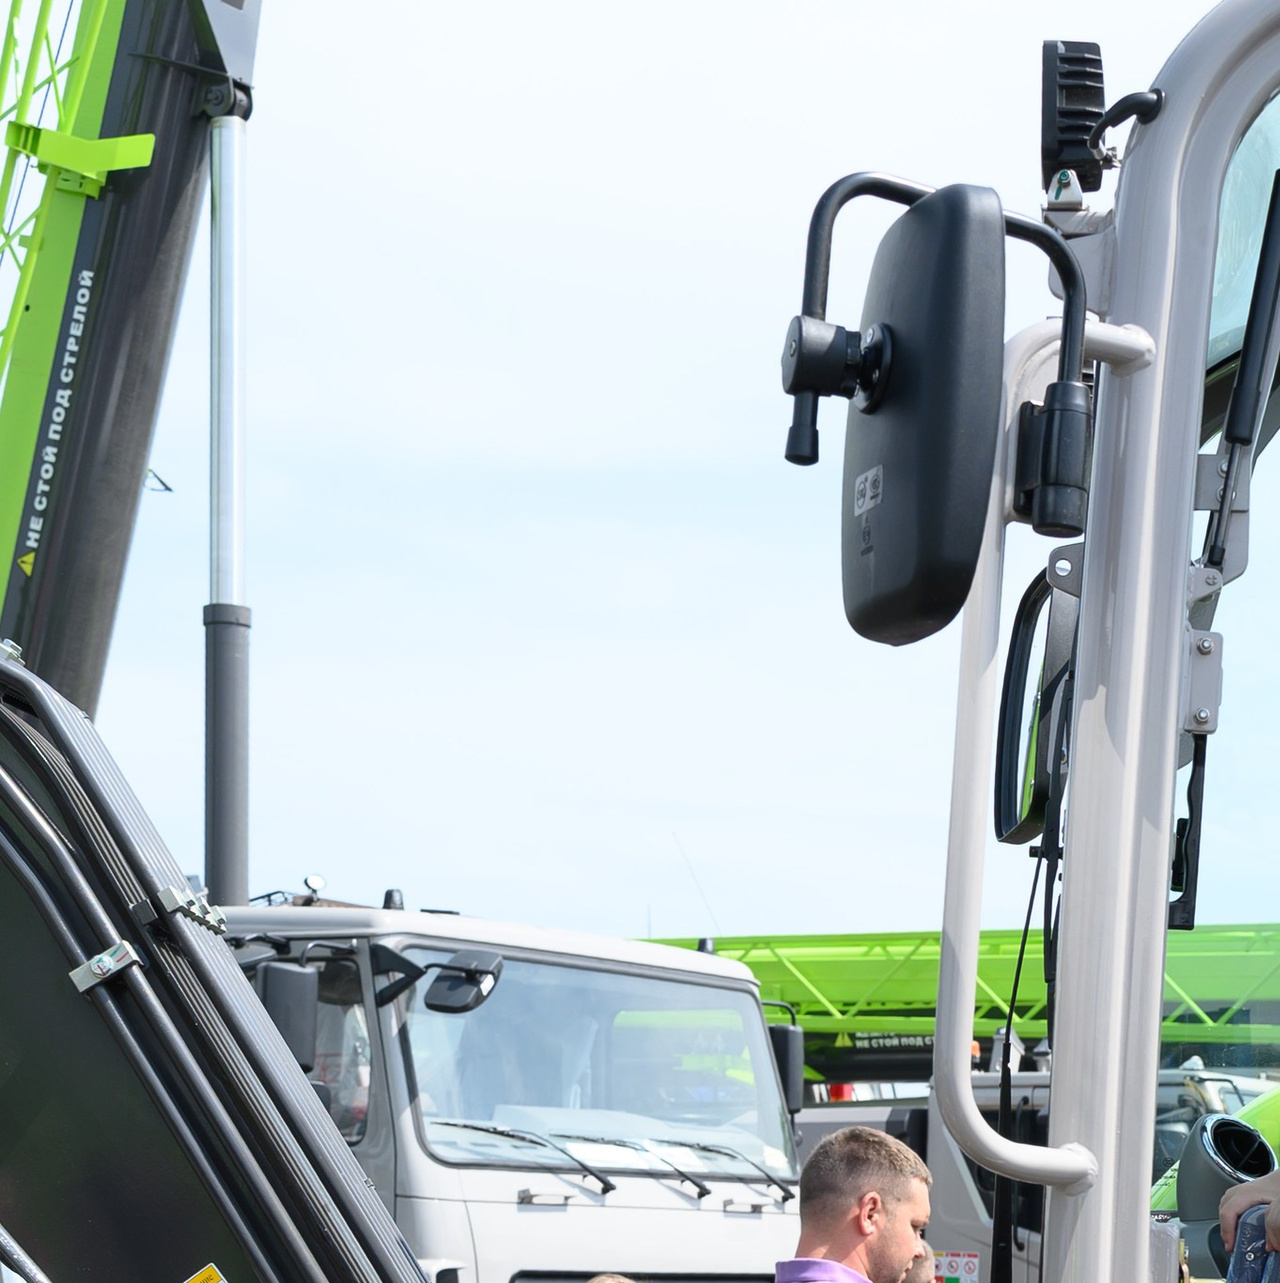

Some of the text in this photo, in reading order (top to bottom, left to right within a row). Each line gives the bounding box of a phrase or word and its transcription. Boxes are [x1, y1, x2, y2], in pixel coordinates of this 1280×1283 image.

[26, 269, 94, 549] НЕ СТОЙ ПОД СТРЕЛОЙ
[855, 1039, 870, 1049] НЕ
[871, 1036, 899, 1048] СТОЙ
[900, 1036, 924, 1048] ПОД
